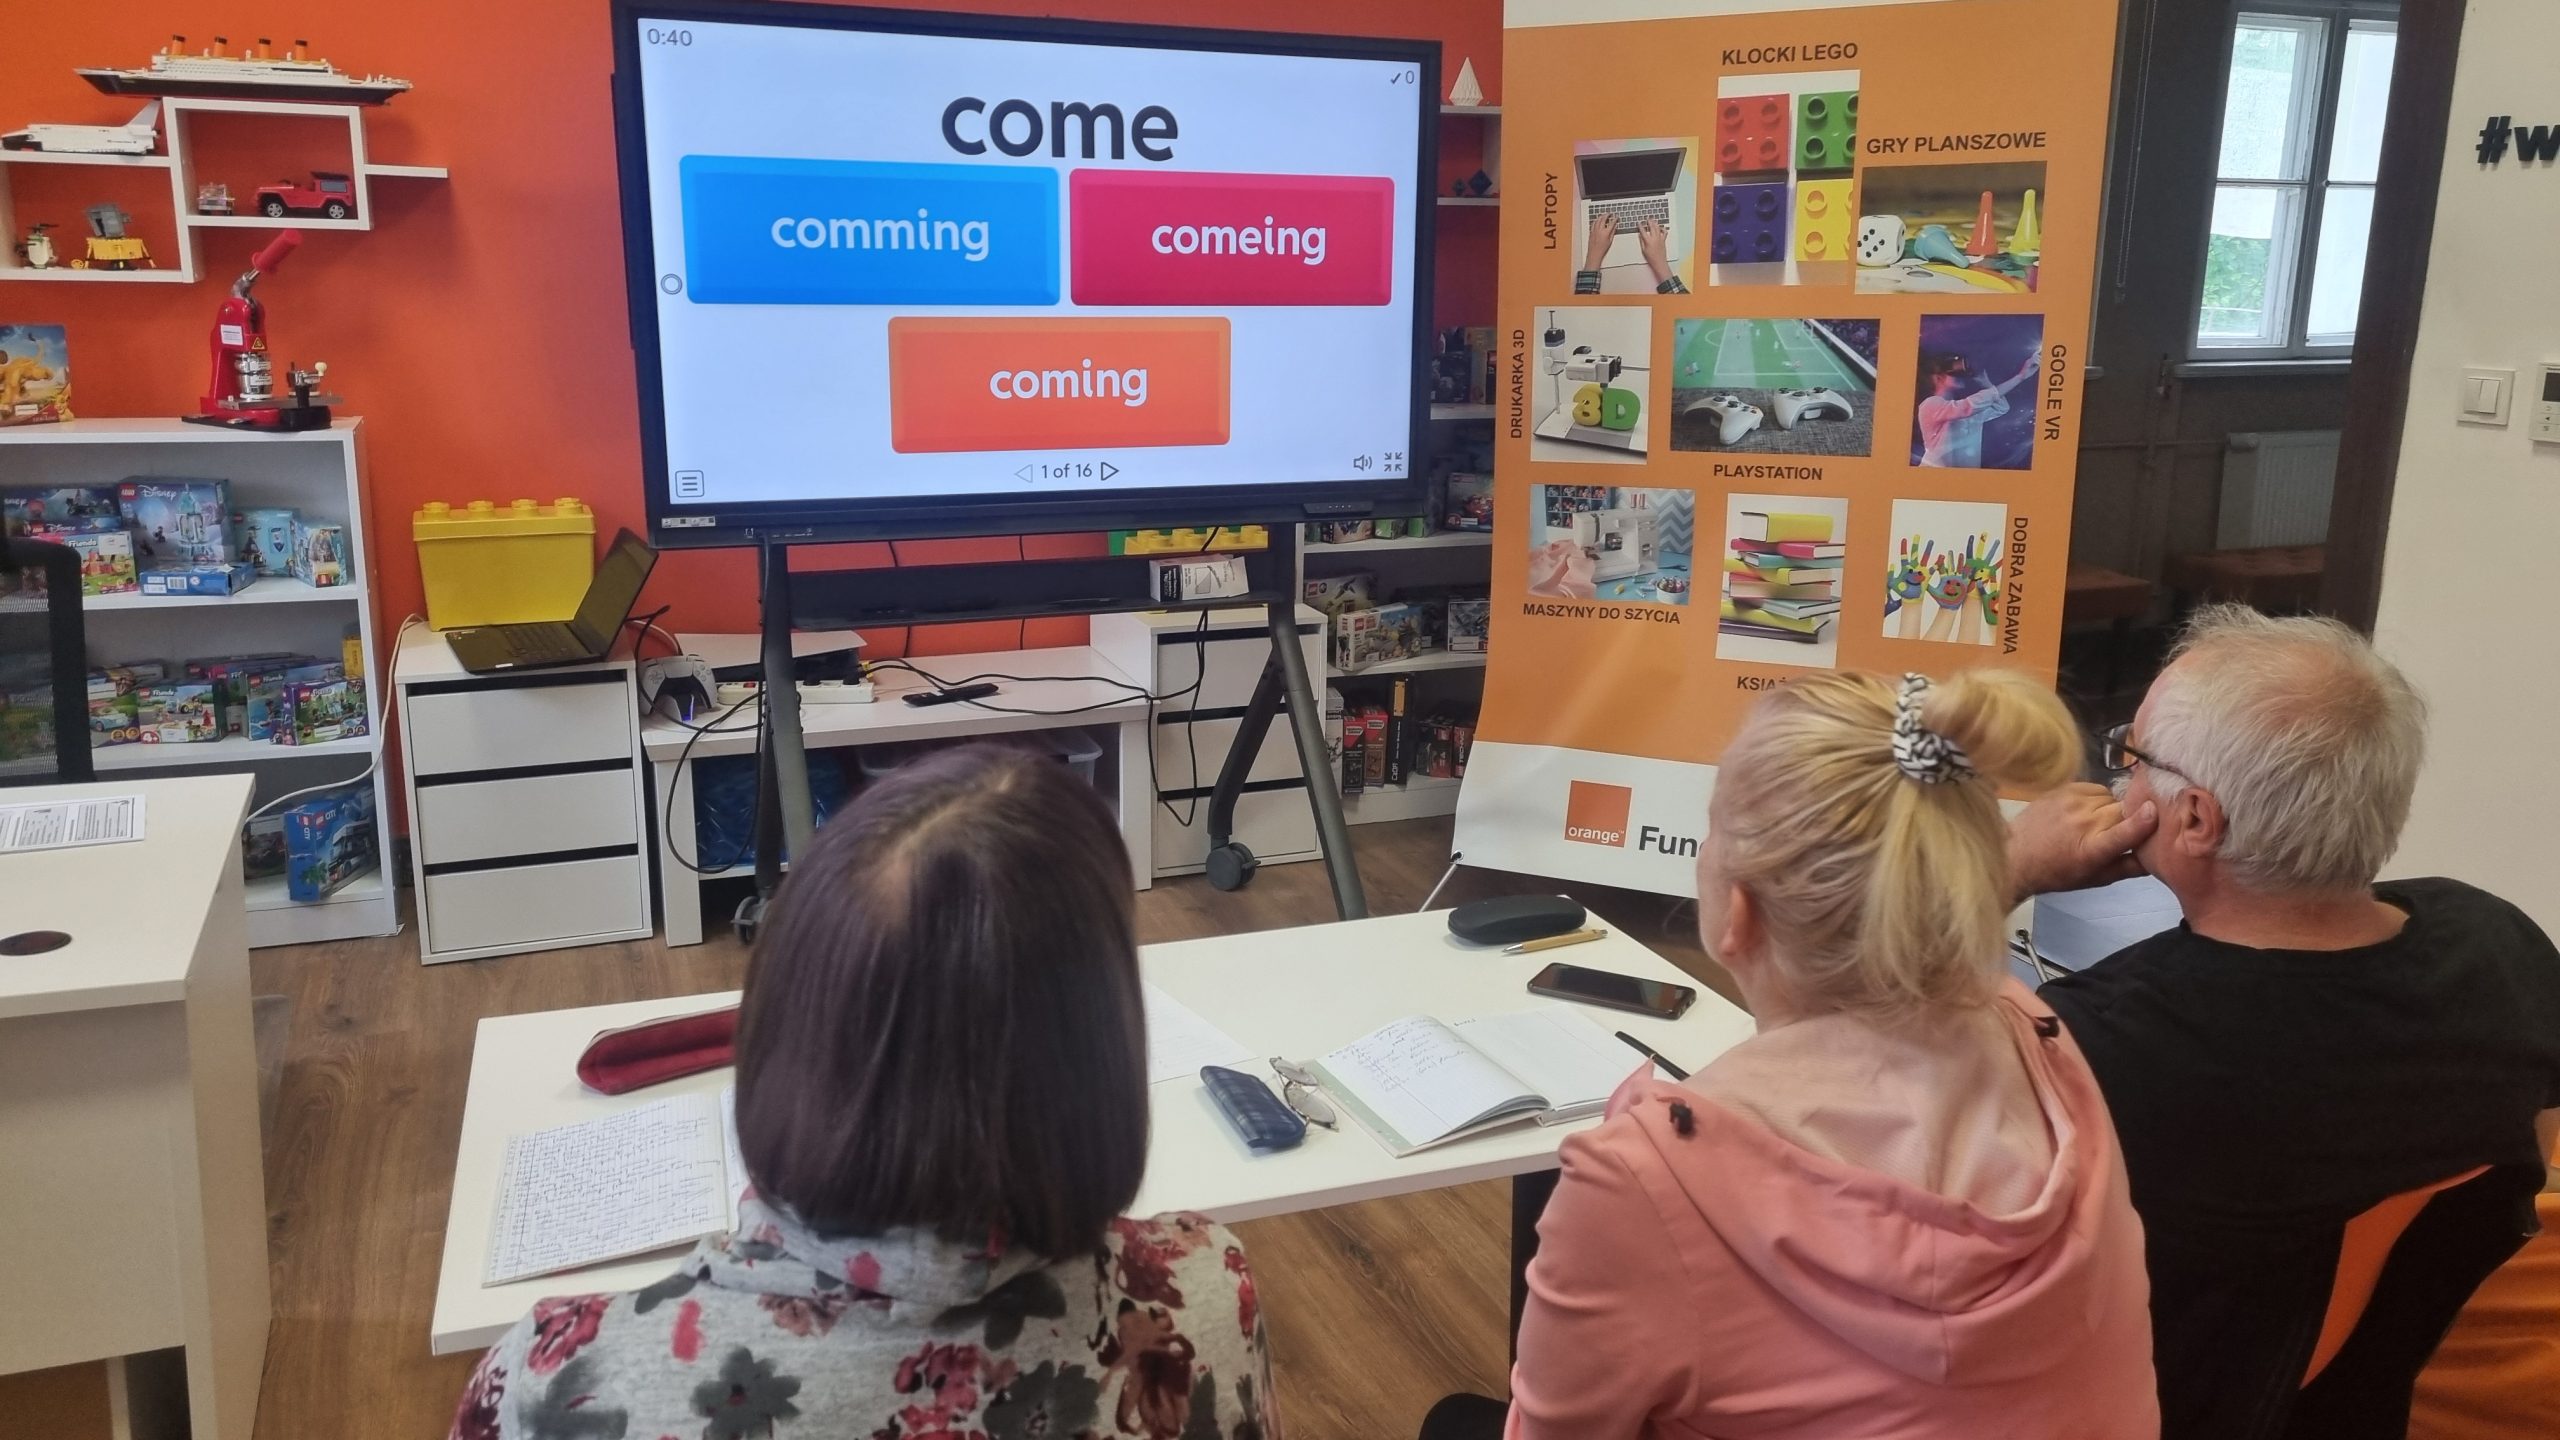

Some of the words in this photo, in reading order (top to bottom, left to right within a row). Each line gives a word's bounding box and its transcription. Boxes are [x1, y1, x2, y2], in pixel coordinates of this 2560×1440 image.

[647, 28, 693, 47] 0:40
[1722, 46, 1796, 66] KLOCKI
[1802, 42, 1858, 61] LEGO
[1405, 70, 1415, 85] 0
[941, 96, 1179, 162] come
[1866, 137, 1910, 155] GRY
[1914, 131, 2047, 153] PLANSZOWE
[1543, 172, 1558, 250] LAPTOPY
[771, 208, 989, 262] comming
[1151, 215, 1326, 266] comeing
[1512, 329, 1525, 349] 3D
[989, 358, 1147, 407] coming
[2046, 344, 2067, 410] GOGLE
[1510, 352, 1525, 439] DRUKARKA
[2043, 415, 2061, 441] VR
[1041, 464, 1048, 479] 1
[1053, 463, 1070, 479] of
[1075, 463, 1093, 479] 16
[1713, 464, 1823, 481] PLAYSTATION
[2009, 517, 2029, 578] DOBRA
[1523, 603, 1597, 619] MASZYNY
[1599, 606, 1621, 620] DO
[1624, 608, 1681, 625] SZYCIA
[2003, 583, 2023, 655] ZABAWA
[1567, 825, 1620, 845] orange
[1638, 824, 1704, 858] Fun
